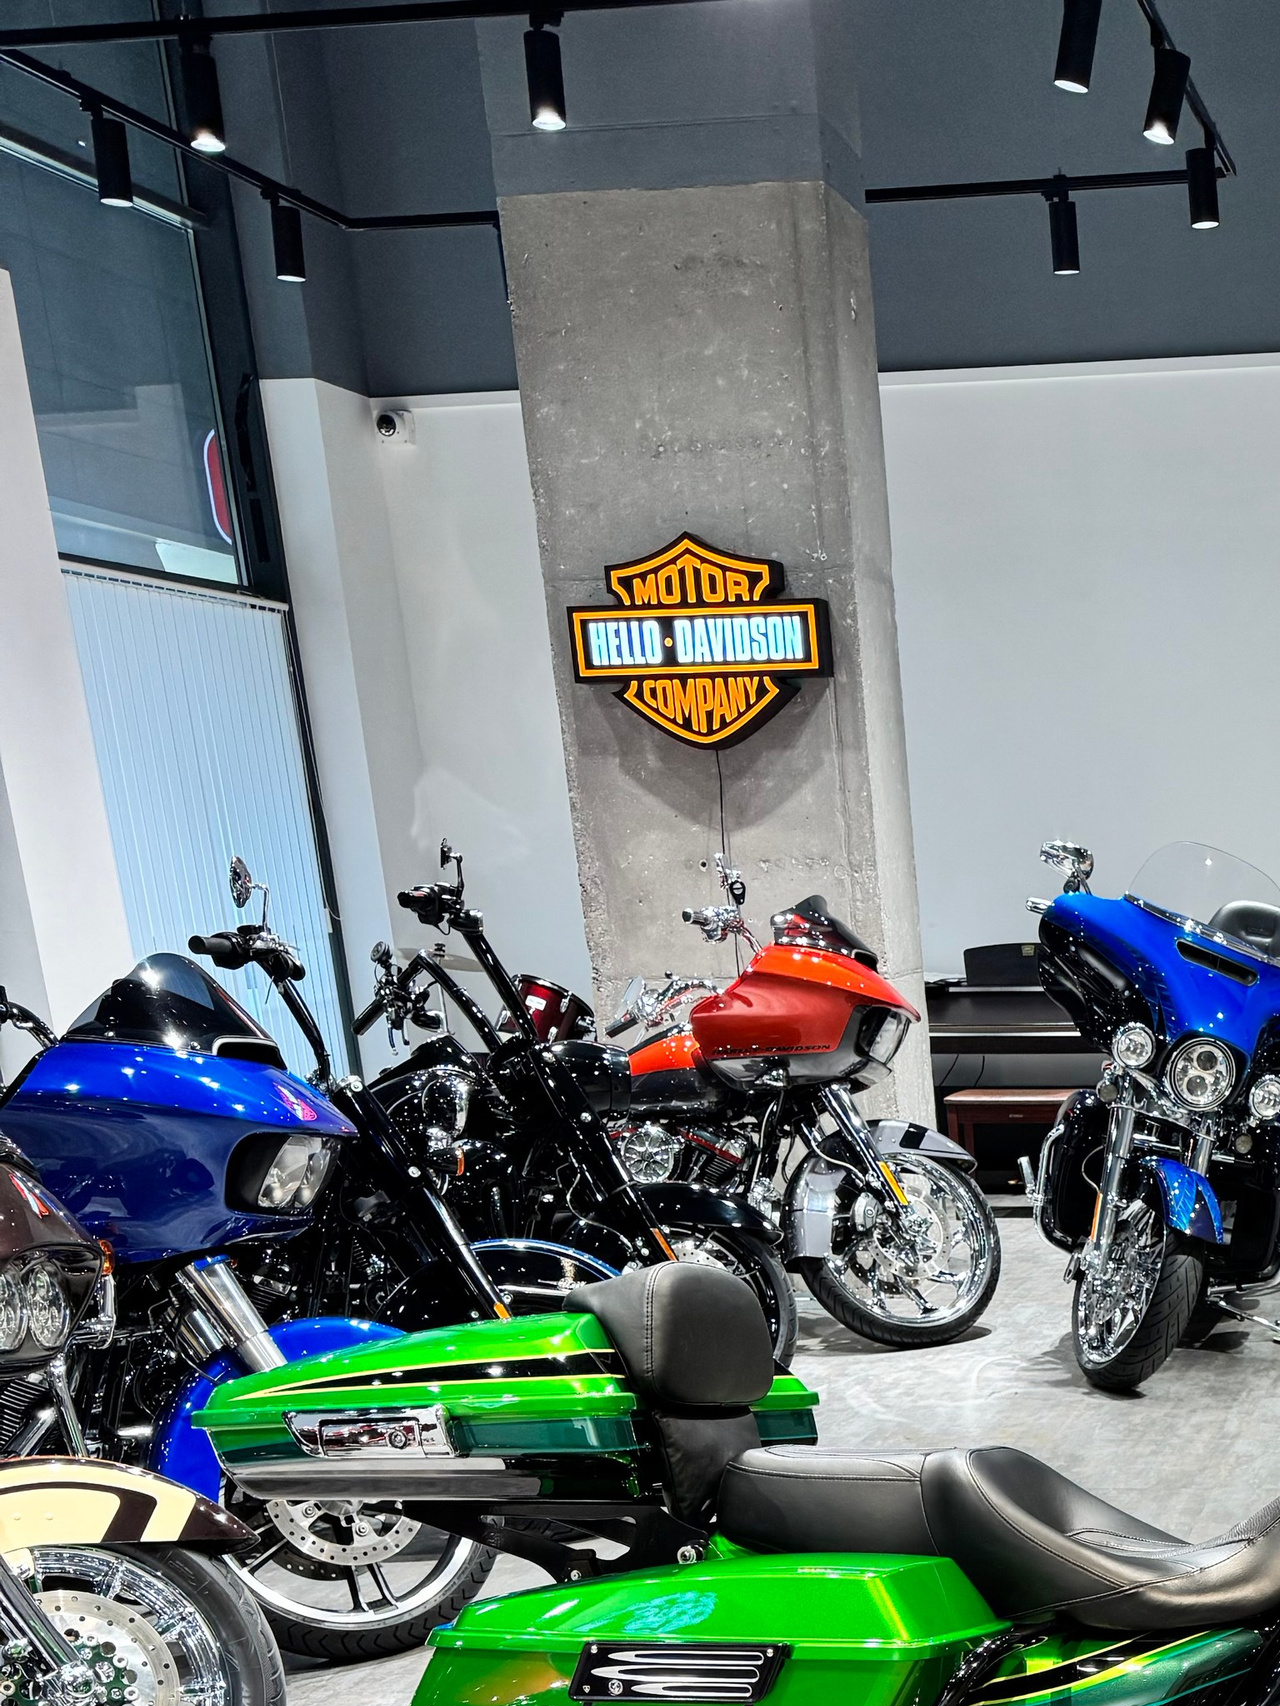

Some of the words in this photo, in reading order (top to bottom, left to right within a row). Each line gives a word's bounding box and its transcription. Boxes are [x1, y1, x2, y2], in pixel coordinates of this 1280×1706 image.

[633, 554, 750, 605] MOTOR
[588, 619, 663, 666] HELLO
[674, 615, 804, 664] DAVIDSON
[643, 676, 760, 733] COMPANY
